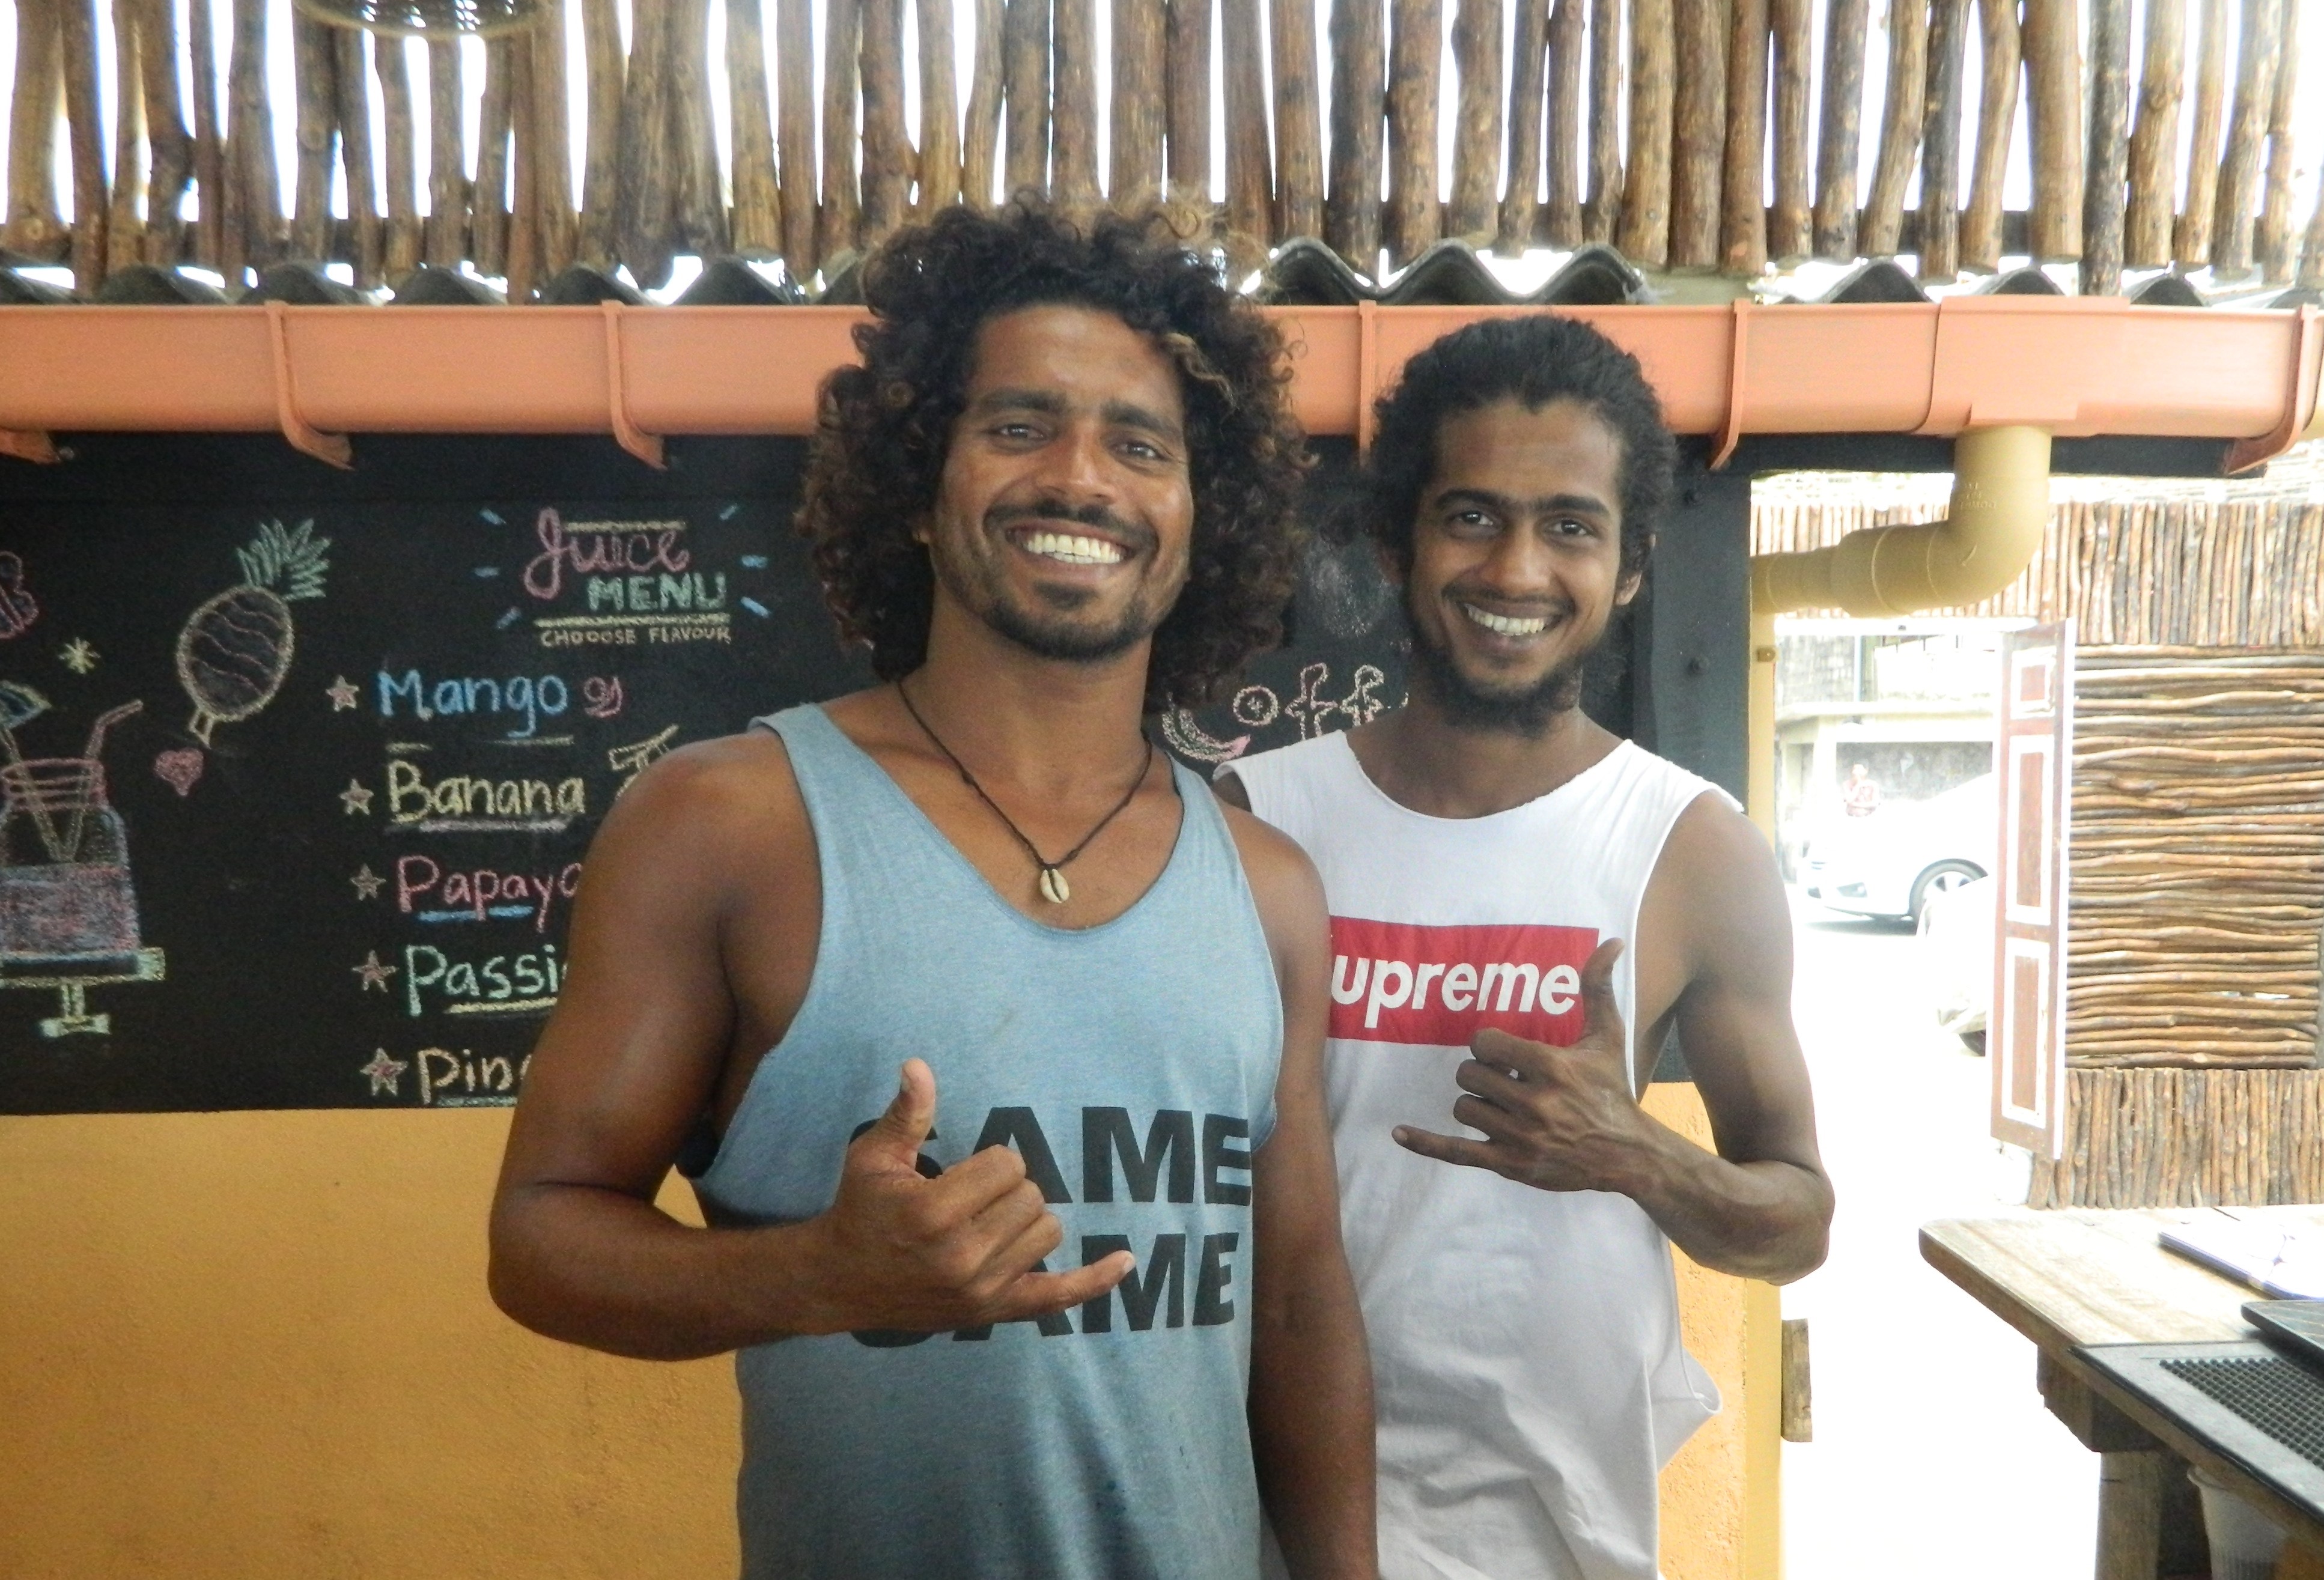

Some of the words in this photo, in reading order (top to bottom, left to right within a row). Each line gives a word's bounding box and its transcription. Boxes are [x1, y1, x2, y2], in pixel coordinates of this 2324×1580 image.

[523, 507, 690, 600] Juice
[587, 573, 727, 611] MENU
[648, 625, 732, 645] FLAVOUR
[378, 669, 568, 738] Mango
[386, 759, 586, 824] Banana
[406, 944, 568, 1017] Passi
[1330, 953, 1581, 1029] upreme
[418, 1047, 532, 1105] Pin
[848, 1232, 1240, 1348] ME
